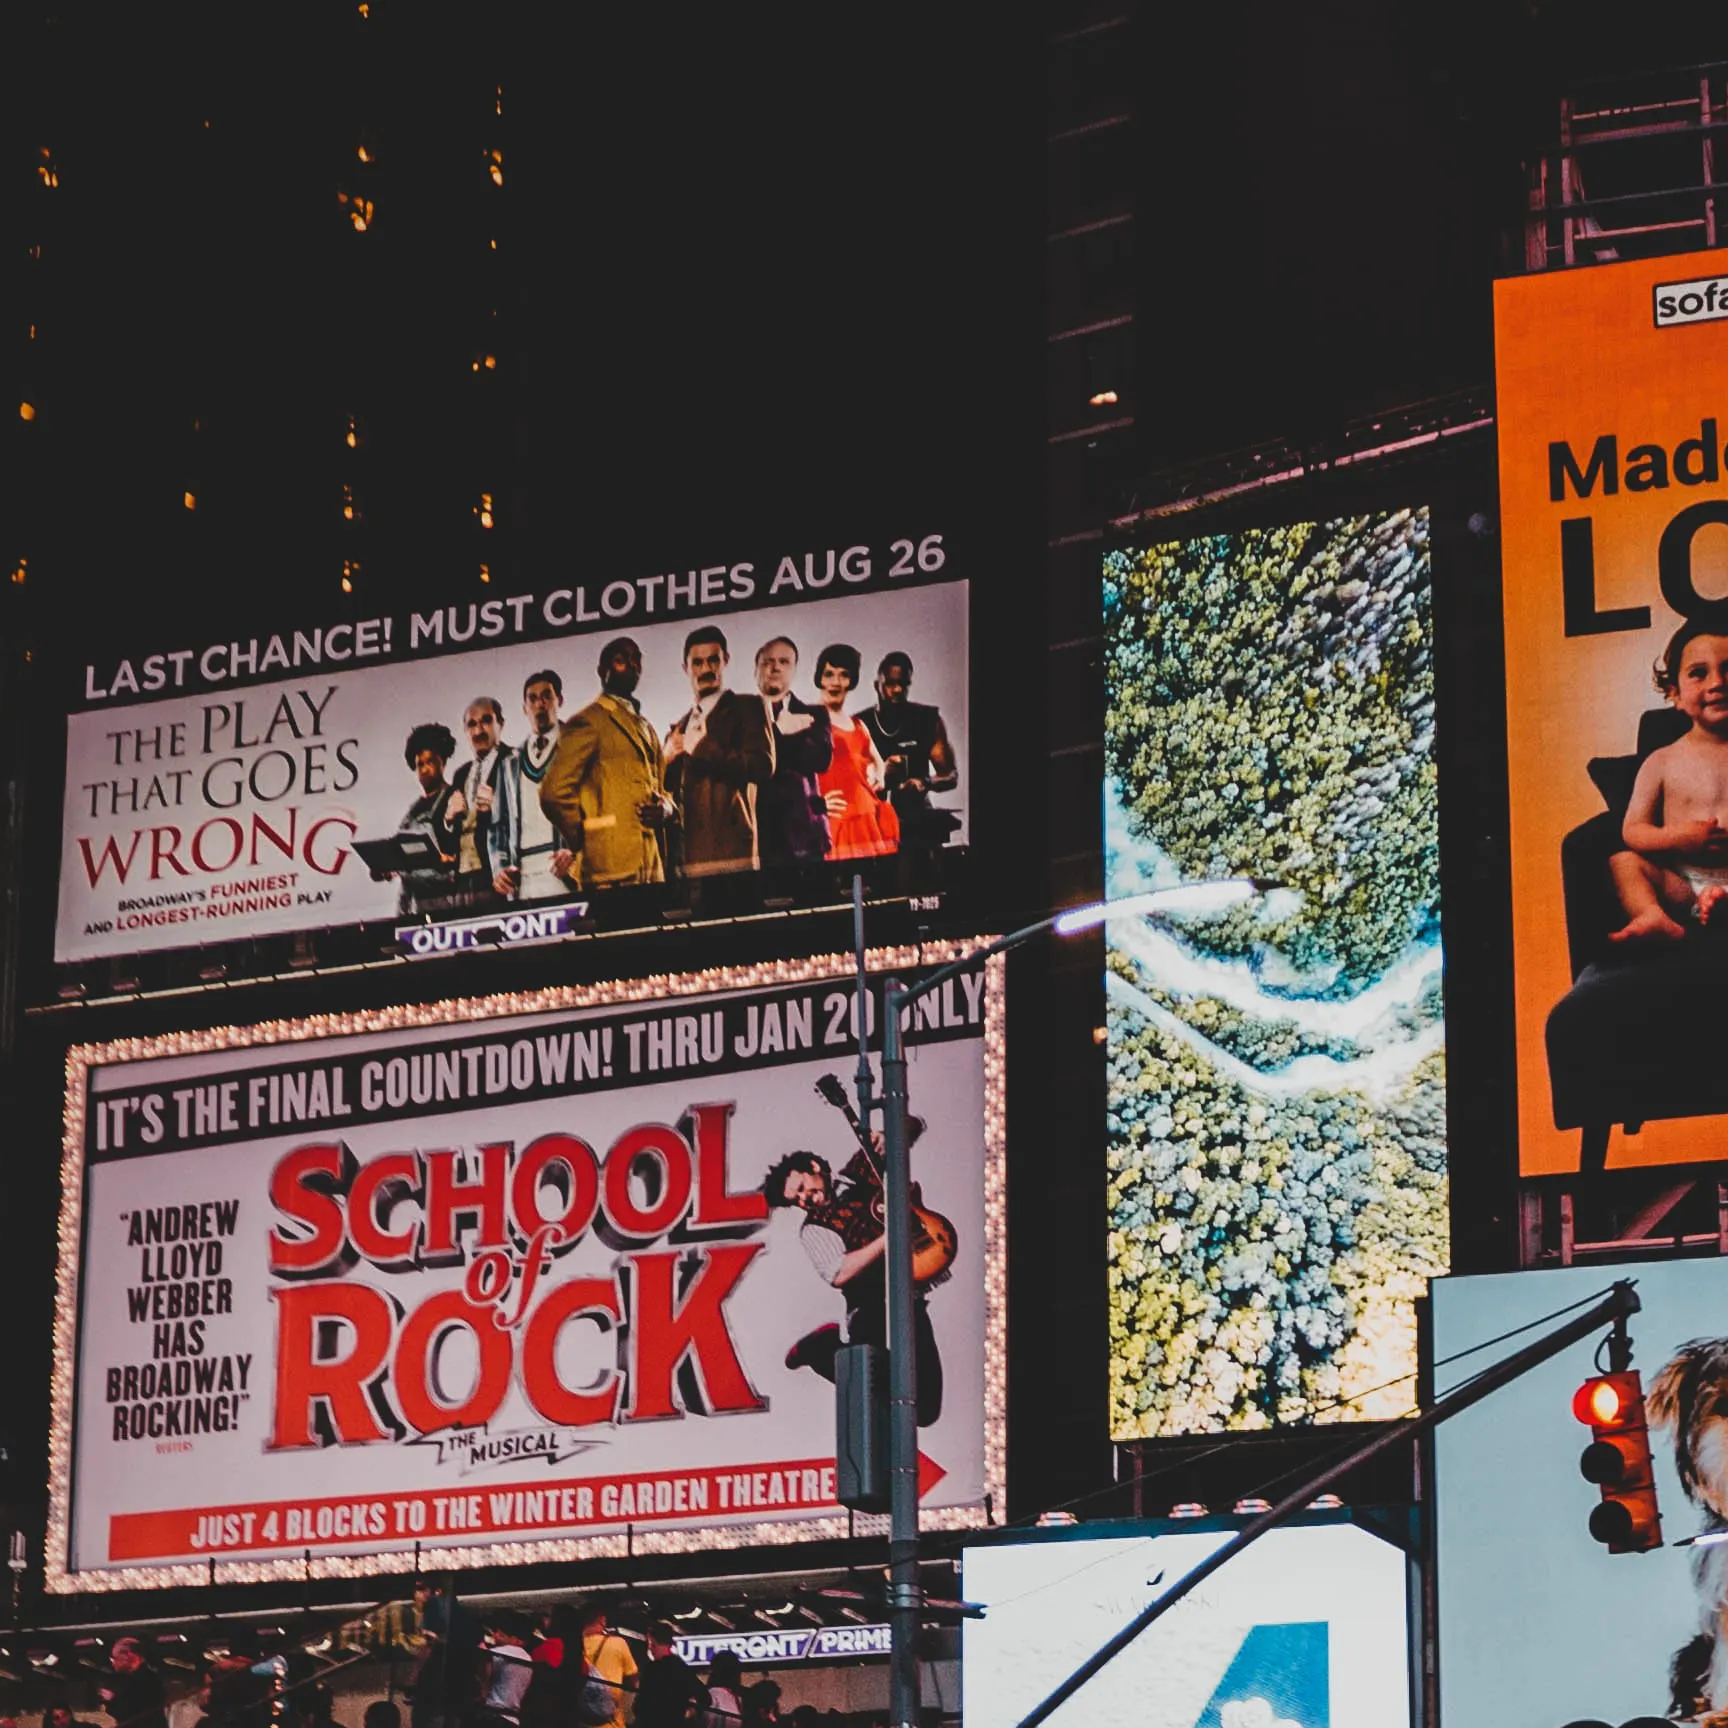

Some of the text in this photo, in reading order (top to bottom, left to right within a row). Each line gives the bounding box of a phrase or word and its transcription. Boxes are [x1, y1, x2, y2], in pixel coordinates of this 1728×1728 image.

[85, 534, 946, 700] LAST CHANCE! MUST CLOTHES AUG 26
[107, 685, 340, 766] THE PLAY
[82, 738, 359, 818] THAT GOES
[76, 807, 358, 890] WRONG
[84, 891, 333, 934] AND LONGEST-RUNNING PLAY
[118, 873, 298, 911] BROADWAY'S FUNNIEST
[412, 911, 565, 953] OUTONT
[96, 1095, 164, 1151] IT'S
[173, 1080, 239, 1139] THE
[248, 1065, 351, 1128] FINAL
[361, 1024, 613, 1112] COUNTDOWN!
[623, 1010, 724, 1073] THRU
[735, 995, 812, 1059] JAN
[824, 990, 876, 1045] 20
[267, 1100, 770, 1278] SCHOOL
[142, 1241, 222, 1284] LLOYD
[464, 1222, 568, 1328] of
[127, 1280, 233, 1323] WEBBER
[153, 1321, 206, 1359] HAS
[263, 1243, 769, 1452] ROCK
[106, 1355, 252, 1403] BROADWAY
[448, 1431, 476, 1451] THE
[471, 1433, 560, 1464] MUSICAL
[191, 1466, 836, 1550] JUST 4 BLOCKS TO THE WINTER GARDEN THEATRE
